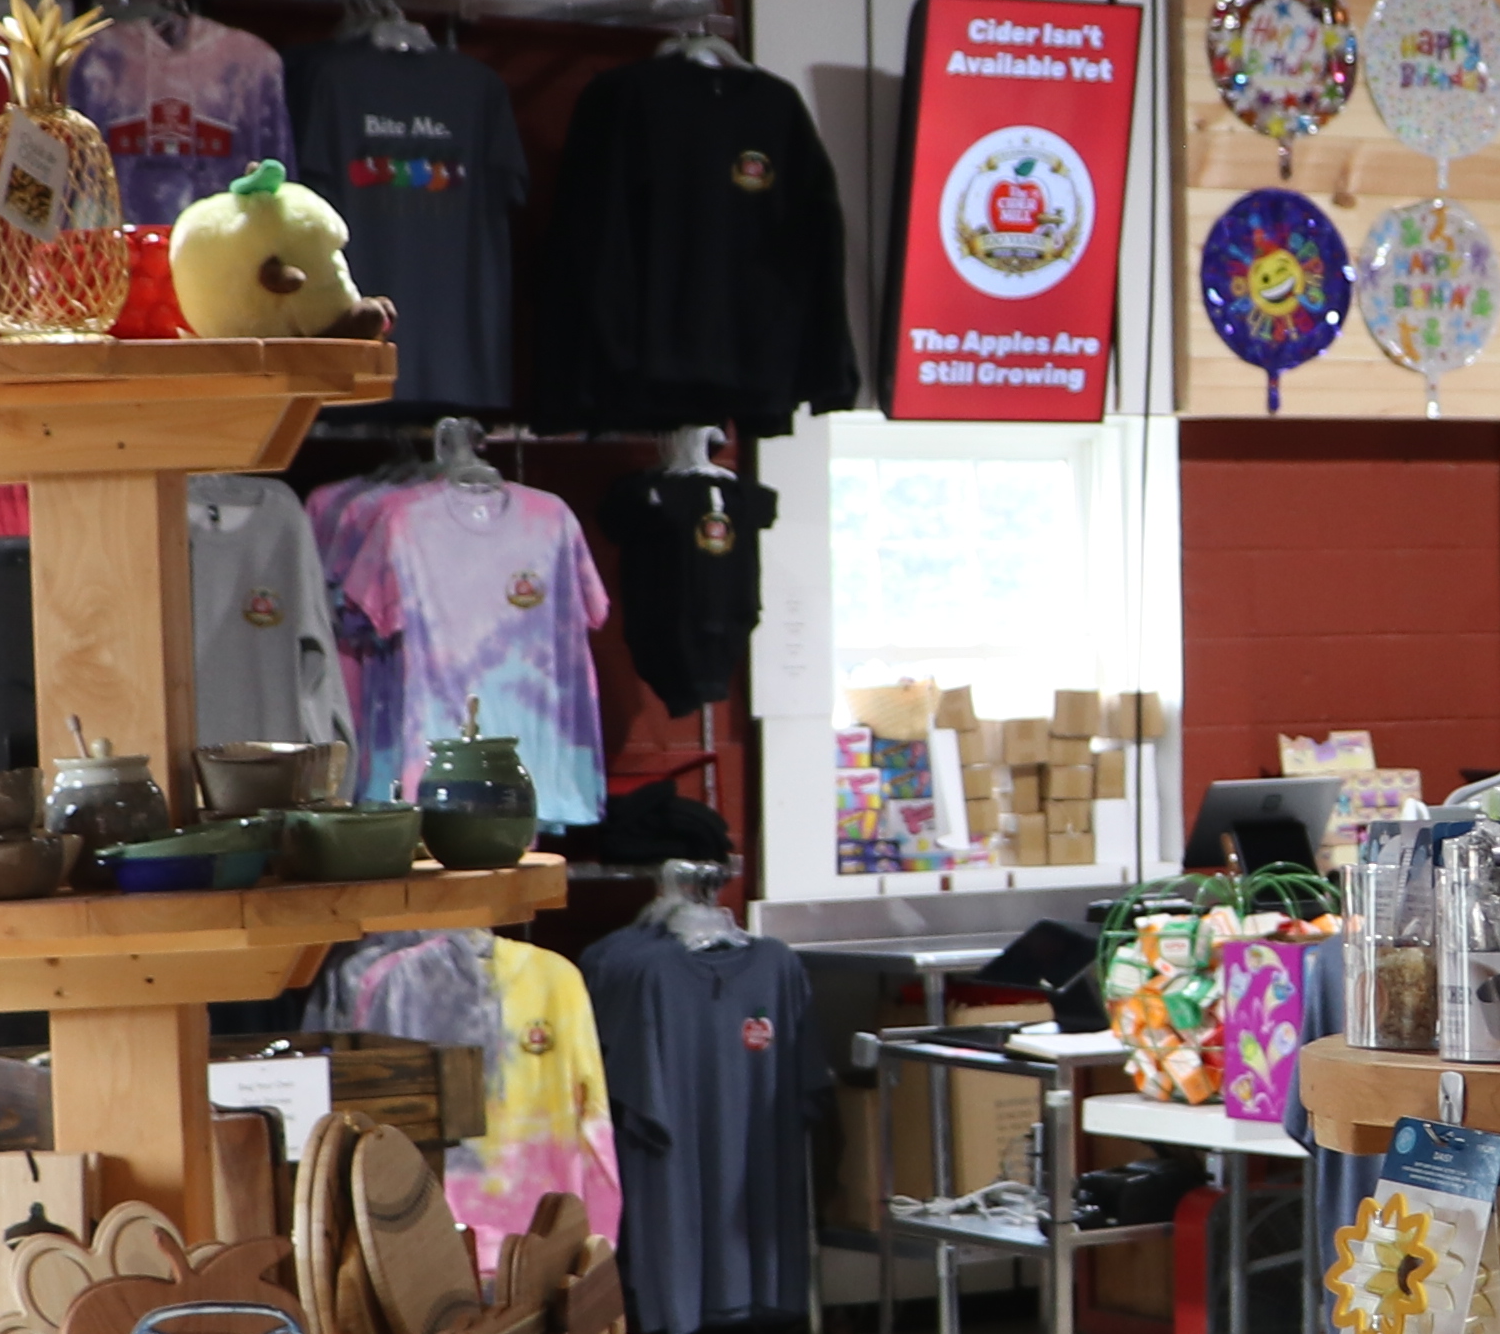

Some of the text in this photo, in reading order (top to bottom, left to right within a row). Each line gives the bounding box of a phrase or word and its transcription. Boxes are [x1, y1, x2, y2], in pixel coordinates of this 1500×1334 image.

[968, 18, 1105, 51] Cider Isn't
[946, 50, 1114, 84] Available Yet
[365, 113, 452, 138] Bite Me.
[910, 328, 1100, 357] The Apples Are
[918, 361, 1086, 393] Still Growing
